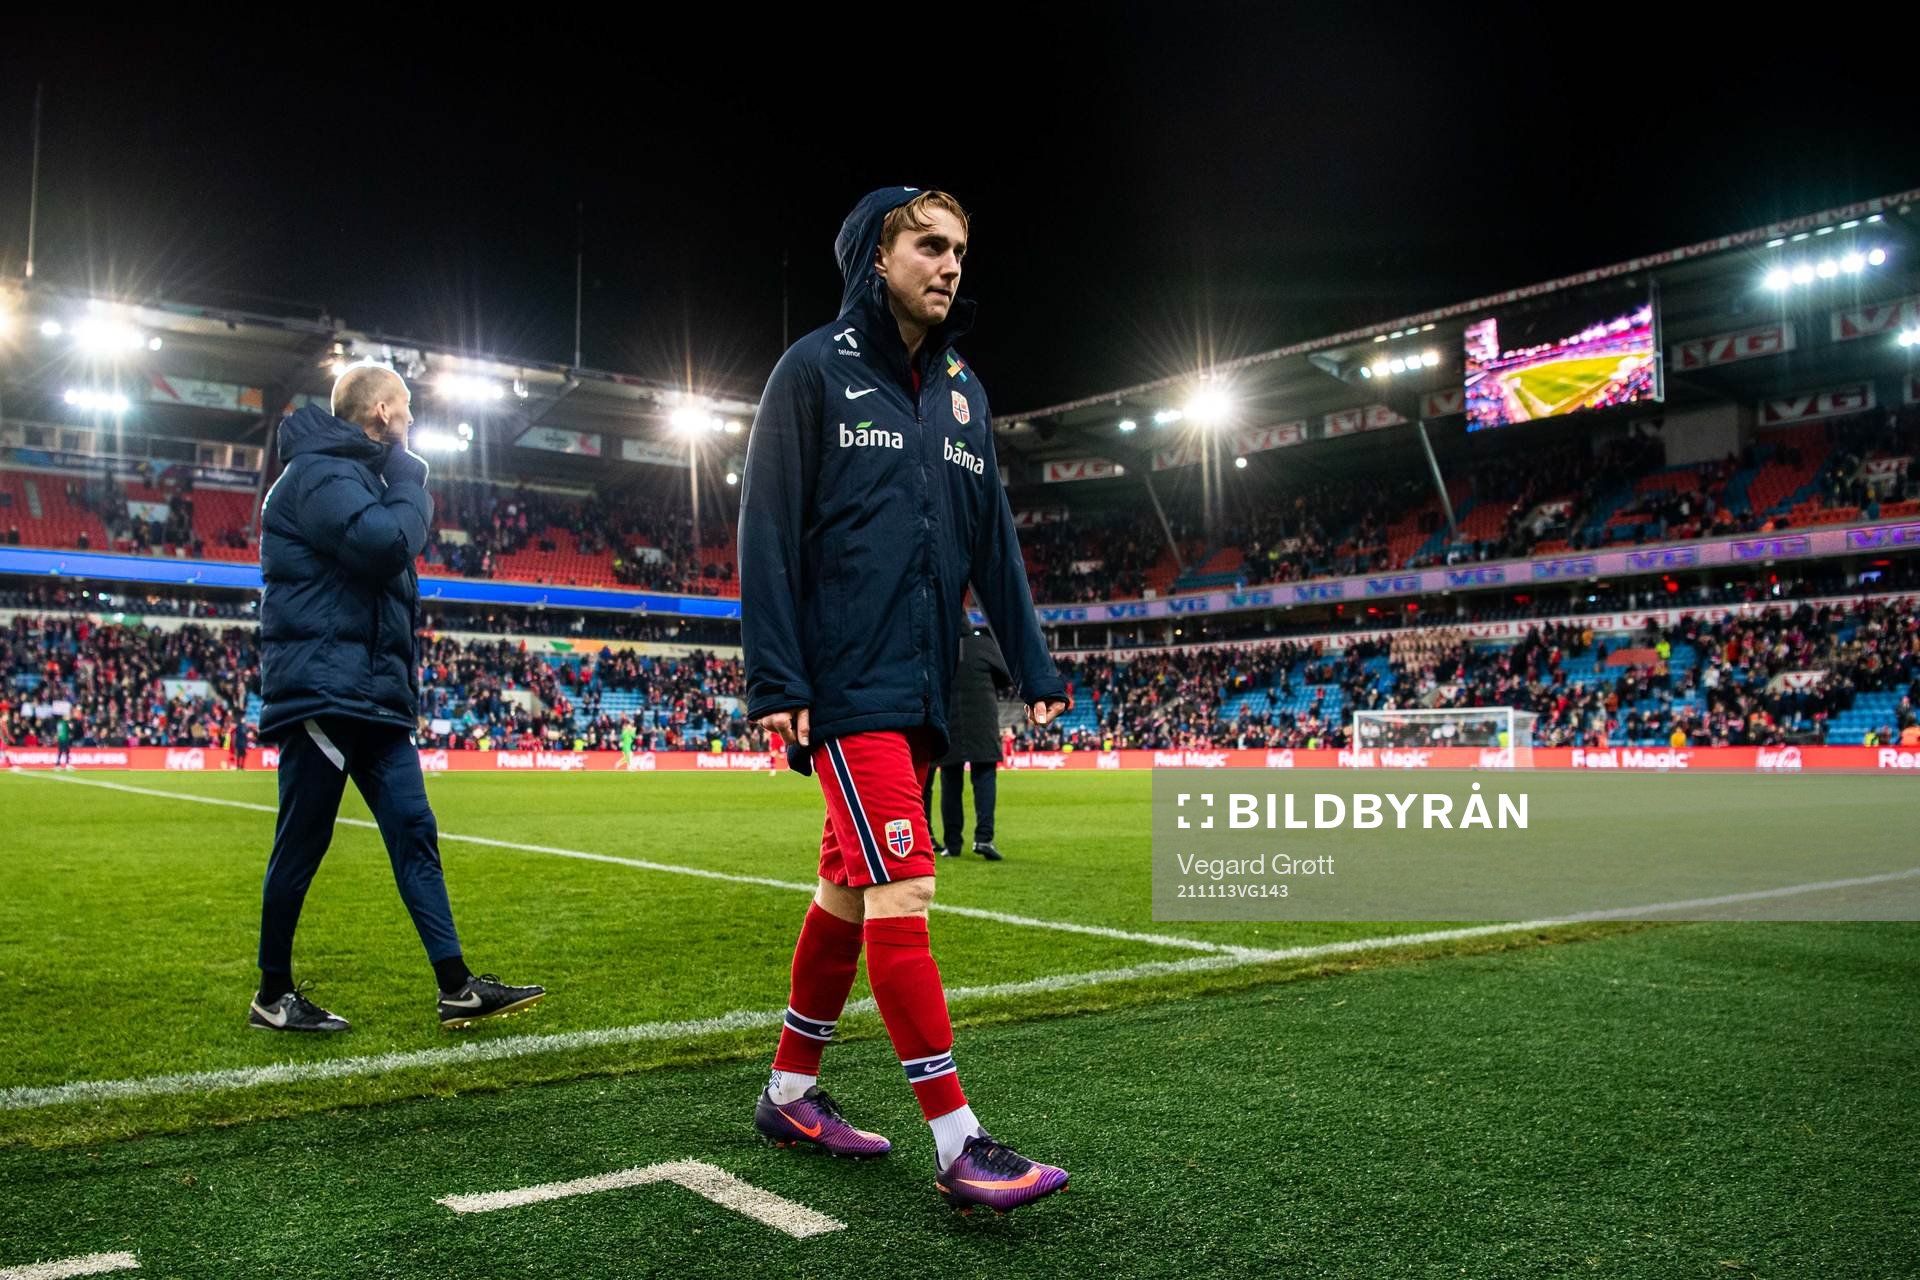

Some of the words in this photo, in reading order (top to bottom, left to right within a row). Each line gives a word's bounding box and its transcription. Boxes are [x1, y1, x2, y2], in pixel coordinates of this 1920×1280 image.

[838, 348, 861, 358] telenor
[1682, 328, 1783, 367] VG
[1765, 385, 1867, 422] VG
[1366, 577, 1421, 594] VG
[1449, 569, 1504, 586] VG
[1535, 559, 1596, 578] VG
[1631, 548, 1695, 569] VG
[1736, 537, 1805, 558] VG
[497, 752, 533, 767] Real
[536, 752, 584, 770] Magic
[697, 753, 728, 768] Real
[730, 753, 771, 770] Magic
[1154, 751, 1183, 767] Real
[1185, 752, 1227, 769] Magic
[1622, 750, 1688, 772] Magic
